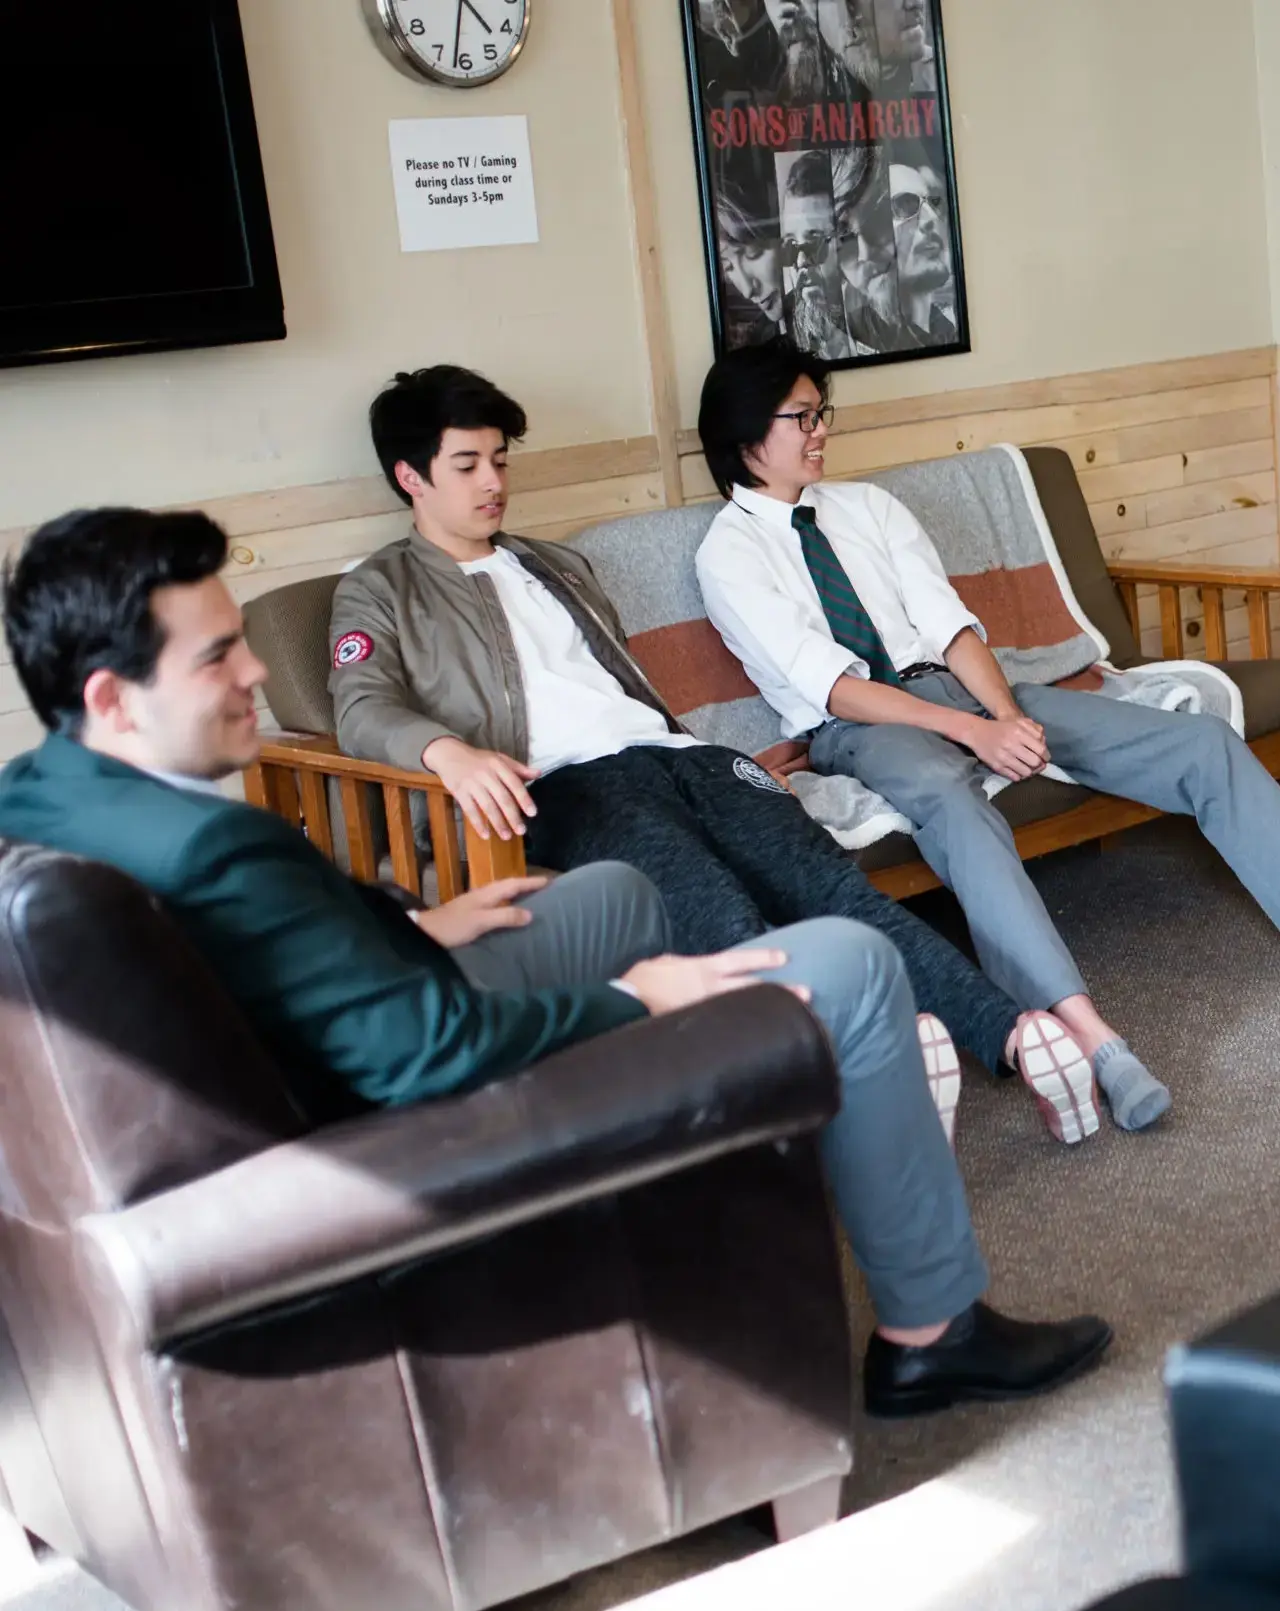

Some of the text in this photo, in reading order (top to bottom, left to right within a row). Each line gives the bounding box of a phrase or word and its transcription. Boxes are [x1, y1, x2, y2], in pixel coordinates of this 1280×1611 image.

[410, 18, 425, 35] 8
[500, 18, 513, 35] 4
[432, 44, 444, 61] 7
[483, 44, 498, 60] 5
[459, 53, 473, 70] 6
[710, 98, 936, 149] SONS OF ANARCHY
[405, 158, 439, 171] Please
[442, 161, 455, 169] no
[457, 156, 470, 168] TV
[481, 155, 517, 168] Gaming
[415, 173, 512, 190] during class time or
[428, 191, 504, 207] Sundays 3-5pm
